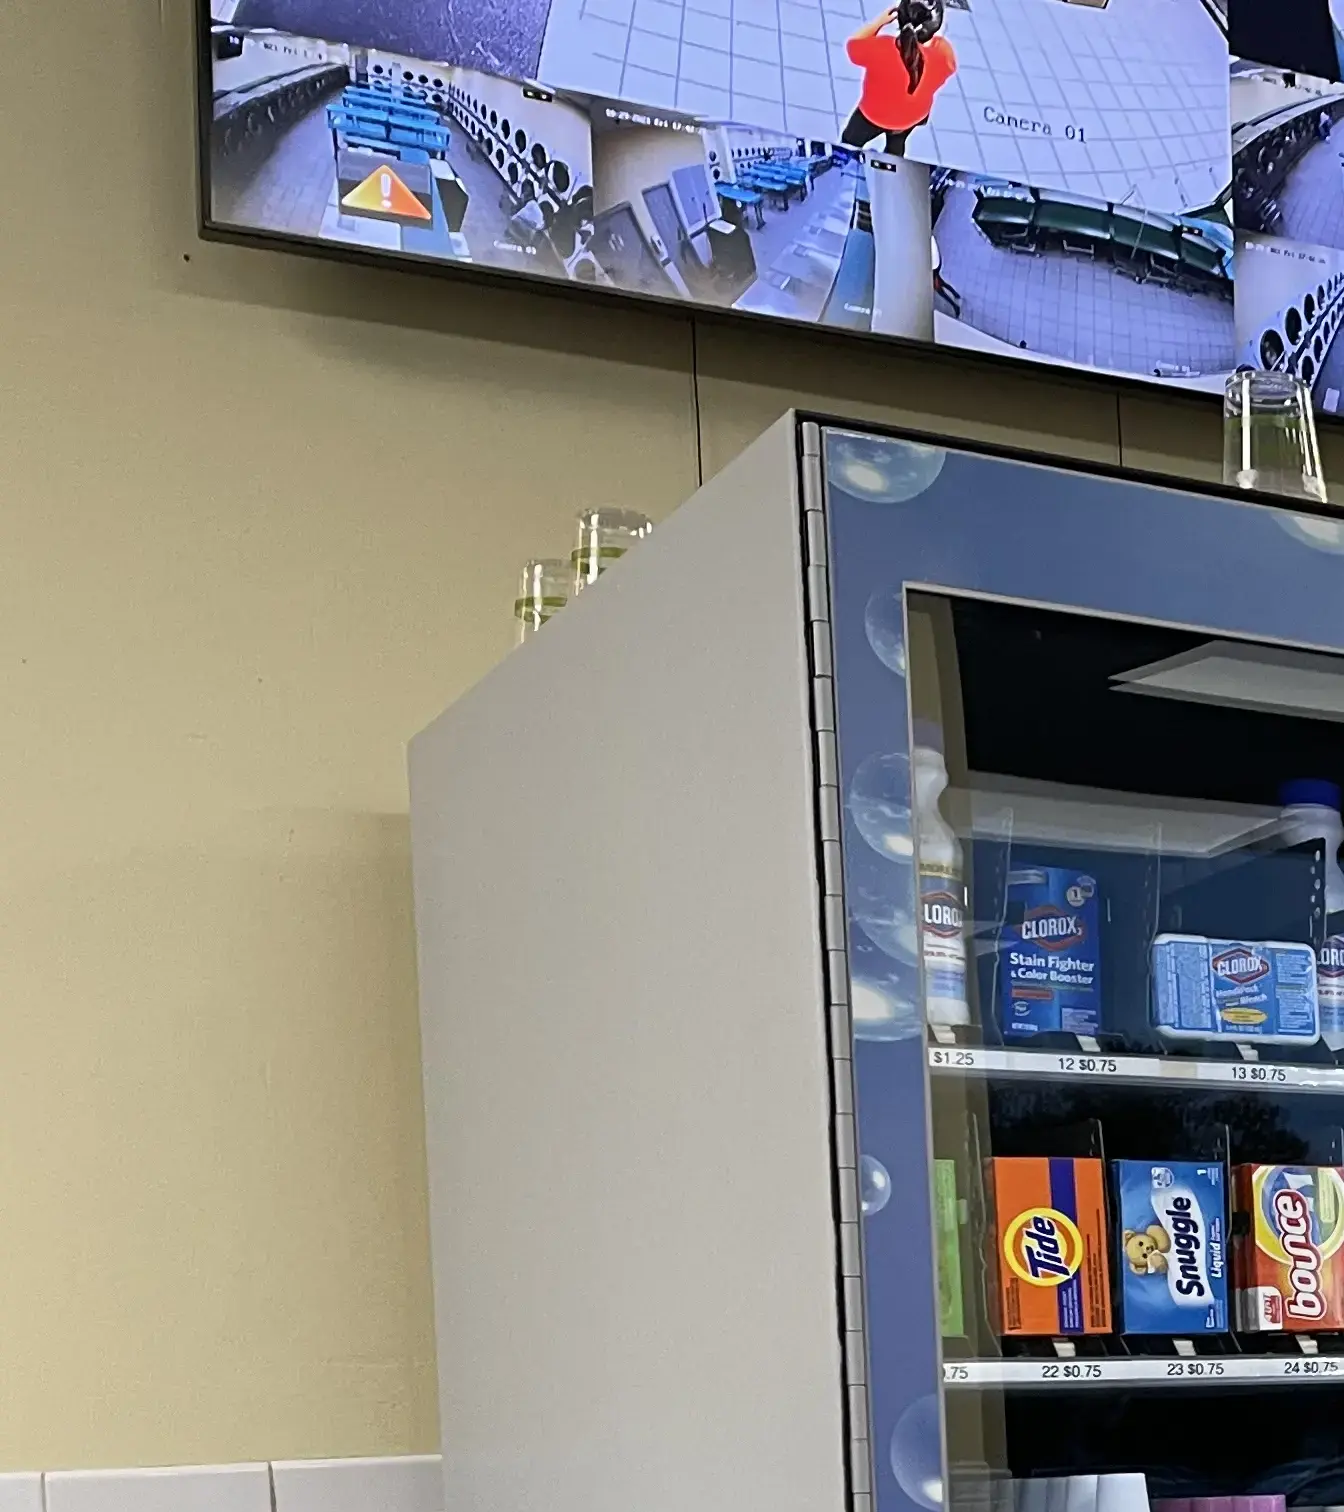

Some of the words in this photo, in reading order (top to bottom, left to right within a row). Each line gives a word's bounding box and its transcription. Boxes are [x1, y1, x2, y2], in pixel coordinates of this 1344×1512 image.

[1065, 125, 1086, 144] 01
[1009, 952, 1046, 968] Stain
[1047, 955, 1095, 972] Fighter
[1216, 955, 1263, 977] CLOROX
[1017, 967, 1048, 981] Color
[1050, 970, 1094, 985] Booster
[933, 1051, 975, 1065] $1.25
[1058, 1057, 1075, 1071] 12
[1079, 1058, 1117, 1072] $0.75
[1232, 1066, 1247, 1079] 13
[1250, 1067, 1286, 1081] $0.75
[1025, 1215, 1071, 1279] Tide
[1165, 1195, 1205, 1297] Snuggle
[1209, 1239, 1224, 1279] Liquid
[1276, 1192, 1324, 1319] bounce
[1041, 1364, 1059, 1379] 22
[1063, 1364, 1102, 1379] $0.75
[1166, 1363, 1184, 1377] 23
[1187, 1362, 1225, 1377] $0.75
[1283, 1361, 1300, 1375] 24
[1303, 1361, 1339, 1374] $0.75
